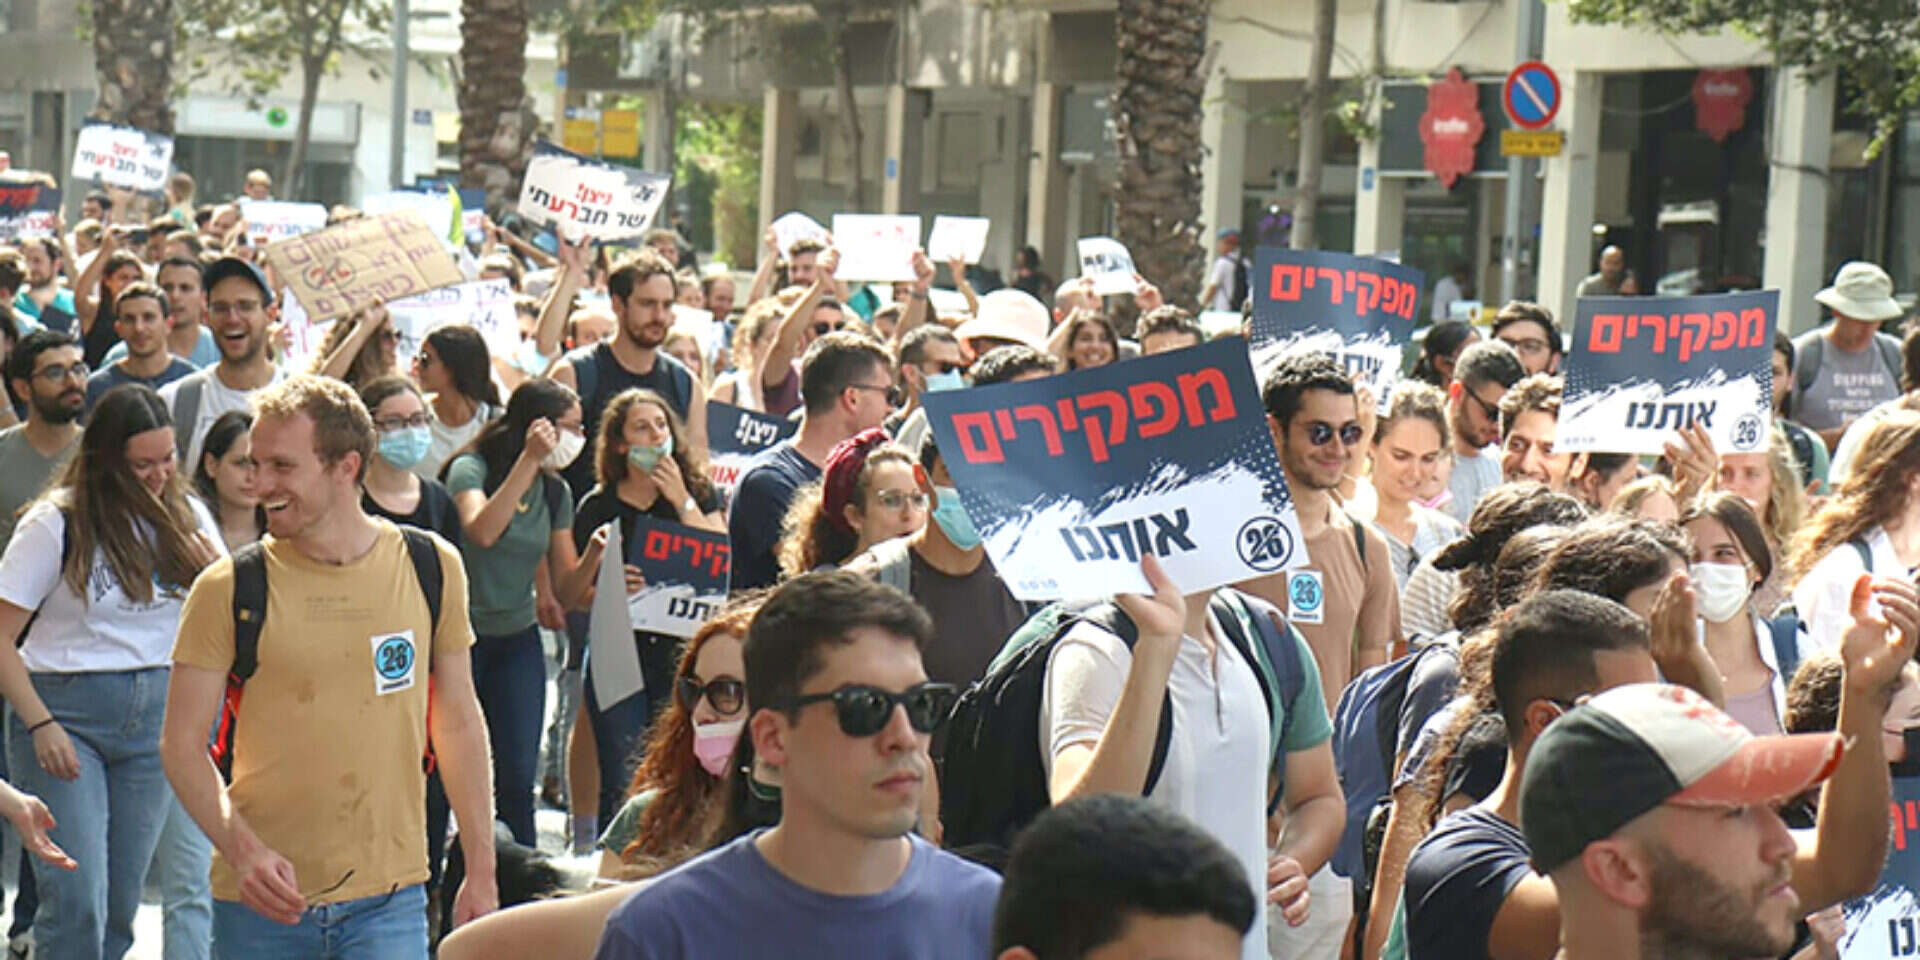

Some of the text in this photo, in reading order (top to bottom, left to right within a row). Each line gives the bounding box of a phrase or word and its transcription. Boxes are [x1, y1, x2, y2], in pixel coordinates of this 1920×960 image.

[528, 185, 647, 228] שר חברעתי
[576, 182, 613, 205] ניצן!
[1270, 264, 1416, 320] מפקירים
[1588, 307, 1766, 363] מפקירים
[736, 413, 779, 446] ניצן!
[951, 366, 1238, 464] מפקירים
[1625, 400, 1717, 431] אותנו
[1735, 420, 1759, 444] 26
[1059, 507, 1198, 563] אותנו
[1246, 524, 1285, 562] 26
[383, 643, 409, 672] 26
